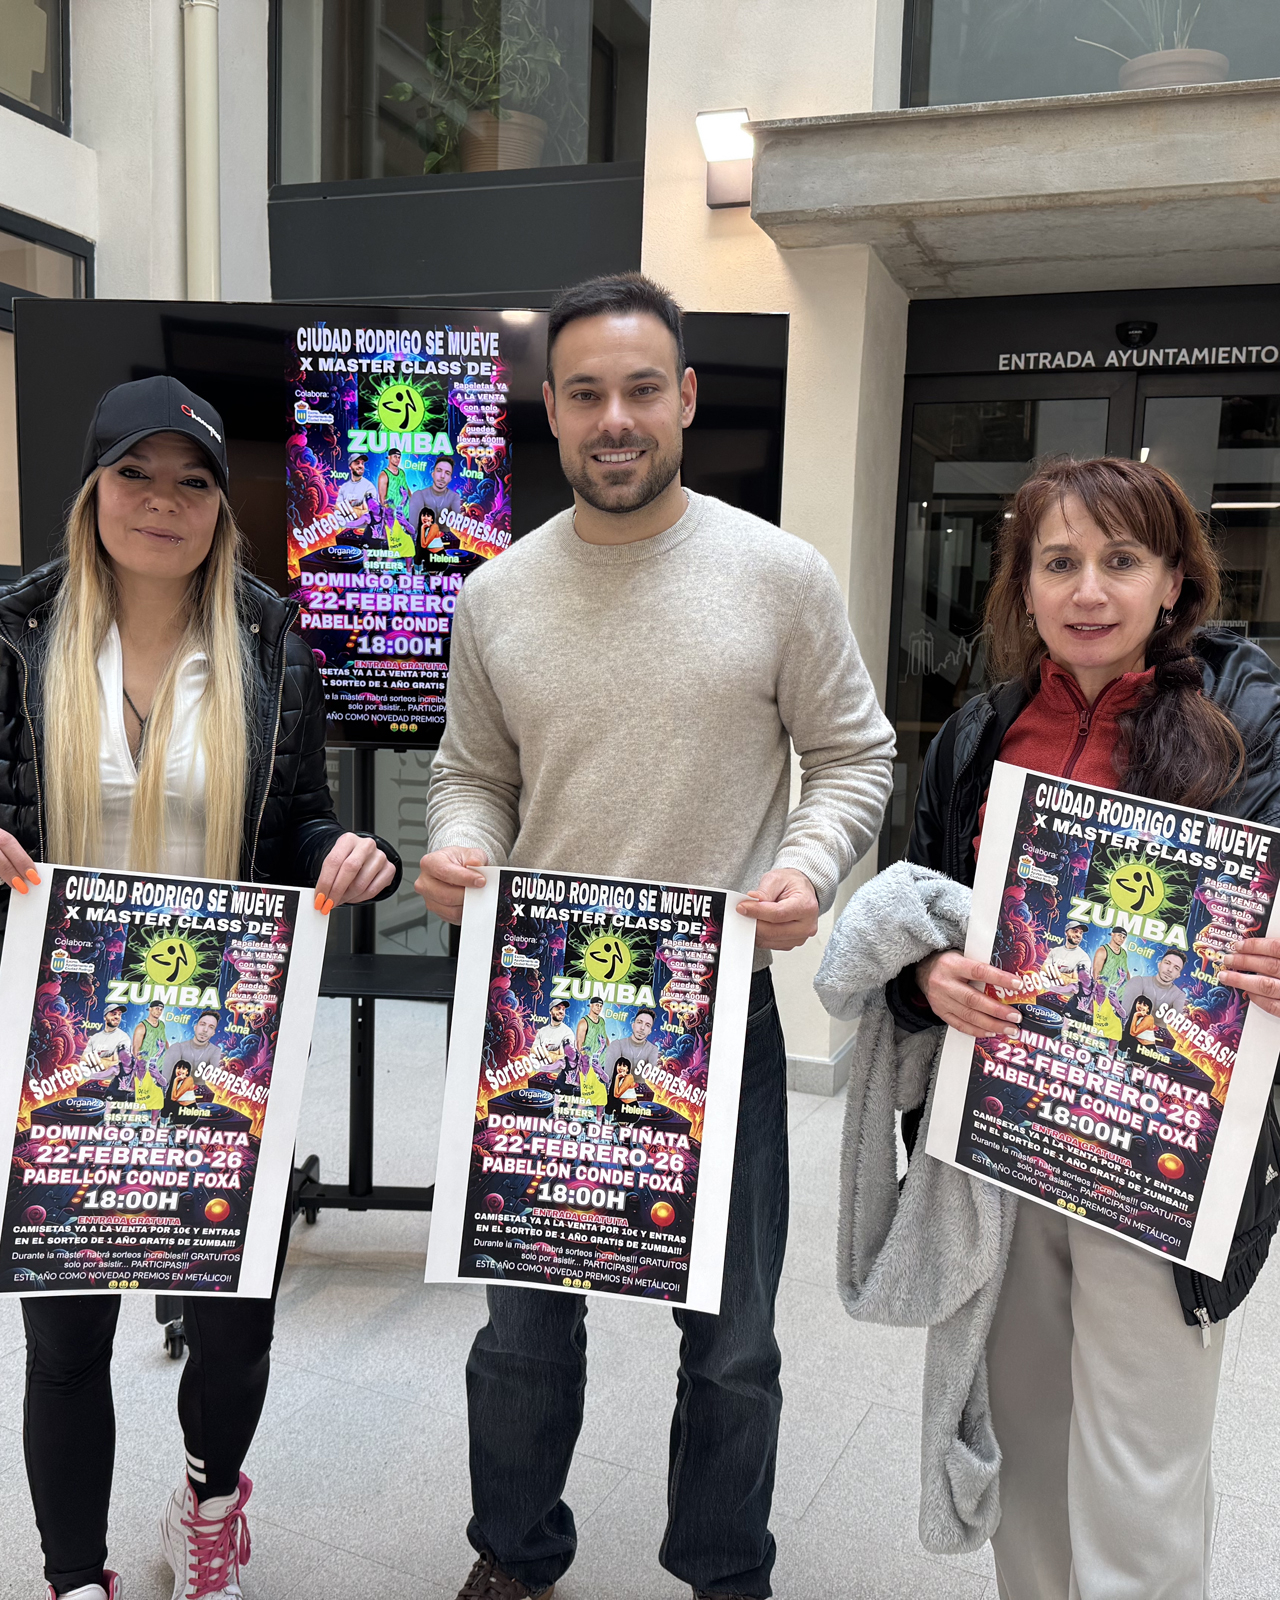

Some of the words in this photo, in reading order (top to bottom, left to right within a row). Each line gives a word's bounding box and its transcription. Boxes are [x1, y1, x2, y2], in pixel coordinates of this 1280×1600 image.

[296, 327, 350, 352] CIUDAD
[355, 329, 421, 354] RODRIGO
[426, 331, 443, 354] SE
[448, 331, 498, 355] MUEVE
[300, 357, 313, 370] X
[318, 357, 396, 373] MASTER
[401, 360, 460, 374] CLASS
[467, 361, 496, 375] DE:
[998, 351, 1096, 371] ENTRADA
[1104, 345, 1279, 368] AYUNTAMIENTO
[295, 389, 328, 398] Colabora:
[348, 430, 453, 454] ZUMBA
[404, 459, 426, 471] Deiff
[459, 467, 483, 479] Jona
[292, 500, 357, 548] Sorteos!!!
[367, 549, 399, 557] ZUMBA
[429, 553, 458, 563] Helena
[363, 561, 403, 569] SISTERS
[301, 571, 393, 589] DOMINGO
[399, 575, 424, 589] DE
[430, 573, 463, 591] PIÑ
[309, 590, 456, 613] 22-FEBRERO
[301, 611, 386, 631] PABELLÓN
[392, 617, 448, 632] CONDE
[357, 635, 442, 656] 18:00H
[354, 660, 398, 669] ENTRADA
[401, 662, 447, 670] GRATUITA
[1032, 783, 1095, 820] CIUDAD
[1097, 798, 1178, 839] RODRIGO
[1178, 817, 1204, 845] SE
[1204, 823, 1271, 862] MUEVE
[1032, 812, 1048, 829] X
[1052, 817, 1142, 852] MASTER
[1145, 840, 1218, 871] CLASS
[1223, 859, 1261, 882] DE:
[63, 876, 127, 903] CIUDAD
[130, 881, 205, 910] RODRIGO
[206, 888, 228, 912] SE
[230, 890, 285, 917] MUEVE
[510, 876, 565, 902] CIUDAD
[568, 881, 635, 909] RODRIGO
[638, 888, 657, 911] SE
[659, 891, 712, 917] MUEVE
[64, 905, 81, 919] X
[85, 907, 173, 927] MASTER
[177, 914, 242, 932] CLASS
[247, 920, 279, 935] DE:
[511, 903, 525, 917] X
[529, 905, 608, 925] MASTER
[611, 913, 671, 931] CLASS
[677, 920, 707, 935] DE:
[1067, 896, 1192, 951] ZUMBA
[54, 937, 93, 947] Colabora:
[503, 933, 537, 944] Colabora:
[1127, 941, 1154, 960] Deiff
[105, 980, 223, 1009] ZUMBA
[550, 976, 657, 1007] ZUMBA
[165, 1012, 190, 1024] Deiff
[604, 1008, 627, 1022] Deiff
[223, 1022, 250, 1034] Jona
[659, 1020, 684, 1034] Jona
[1135, 1043, 1171, 1064] Helena
[28, 1050, 104, 1100] Sorteos!!!
[485, 1043, 552, 1089] Sorteos!!!
[1007, 1028, 1092, 1066] MINGO
[1096, 1055, 1126, 1078] DE
[1131, 1067, 1211, 1109] PIÑATA
[995, 1040, 1203, 1130] 22-FEBRERO-26
[178, 1106, 211, 1116] Helena
[558, 1095, 591, 1105] ZUMBA
[621, 1103, 651, 1116] Helena
[983, 1059, 1076, 1105] PABELLÓN
[1079, 1094, 1144, 1130] CONDE
[1147, 1119, 1198, 1152] FOXÁ
[553, 1106, 594, 1118] SISTERS
[30, 1124, 136, 1142] DOMINGO
[140, 1128, 170, 1143] DE
[175, 1126, 249, 1146] PIÑATA
[487, 1112, 582, 1137] DOMINGO
[587, 1123, 614, 1140] DE
[619, 1125, 689, 1149] PIÑATA
[1037, 1099, 1133, 1151] 18:00H
[35, 1144, 243, 1168] 22-FEBRERO-26
[493, 1133, 685, 1172] 22-FEBRERO-26
[972, 1107, 1026, 1136] CAMISETAS
[1027, 1129, 1040, 1140] YA
[1042, 1136, 1050, 1144] A
[1051, 1139, 1064, 1150] LA
[1066, 1145, 1099, 1164] VENTA
[1100, 1158, 1121, 1172] POR
[1123, 1167, 1141, 1181] 10€
[1143, 1175, 1151, 1185] Y
[1152, 1179, 1194, 1202] ENTRAS
[22, 1165, 121, 1185] PABELLÓN
[125, 1171, 189, 1187] CONDE
[193, 1172, 240, 1189] FOXÁ
[482, 1156, 571, 1180] PABELLÓN
[575, 1166, 634, 1187] CONDE
[638, 1173, 683, 1193] FOXÁ
[83, 1190, 179, 1210] 18:00H
[537, 1182, 626, 1211] 18:00H
[532, 1207, 578, 1221] ENTRADA
[580, 1213, 629, 1227] GRATUITA
[12, 1224, 71, 1234] CAMISETAS
[201, 1228, 240, 1236] ENTRAS
[14, 1237, 27, 1245] EN
[47, 1236, 88, 1244] SORTEO
[90, 1236, 104, 1244] DE
[114, 1235, 137, 1244] AÑO
[138, 1237, 175, 1245] GRATIS
[177, 1238, 191, 1246] DE
[475, 1259, 496, 1269] ESTE
[496, 1259, 515, 1270] AÑO
[516, 1263, 541, 1273] COMO
[543, 1266, 583, 1278] NOVEDAD
[584, 1271, 620, 1283] PREMIOS
[621, 1276, 632, 1285] EN
